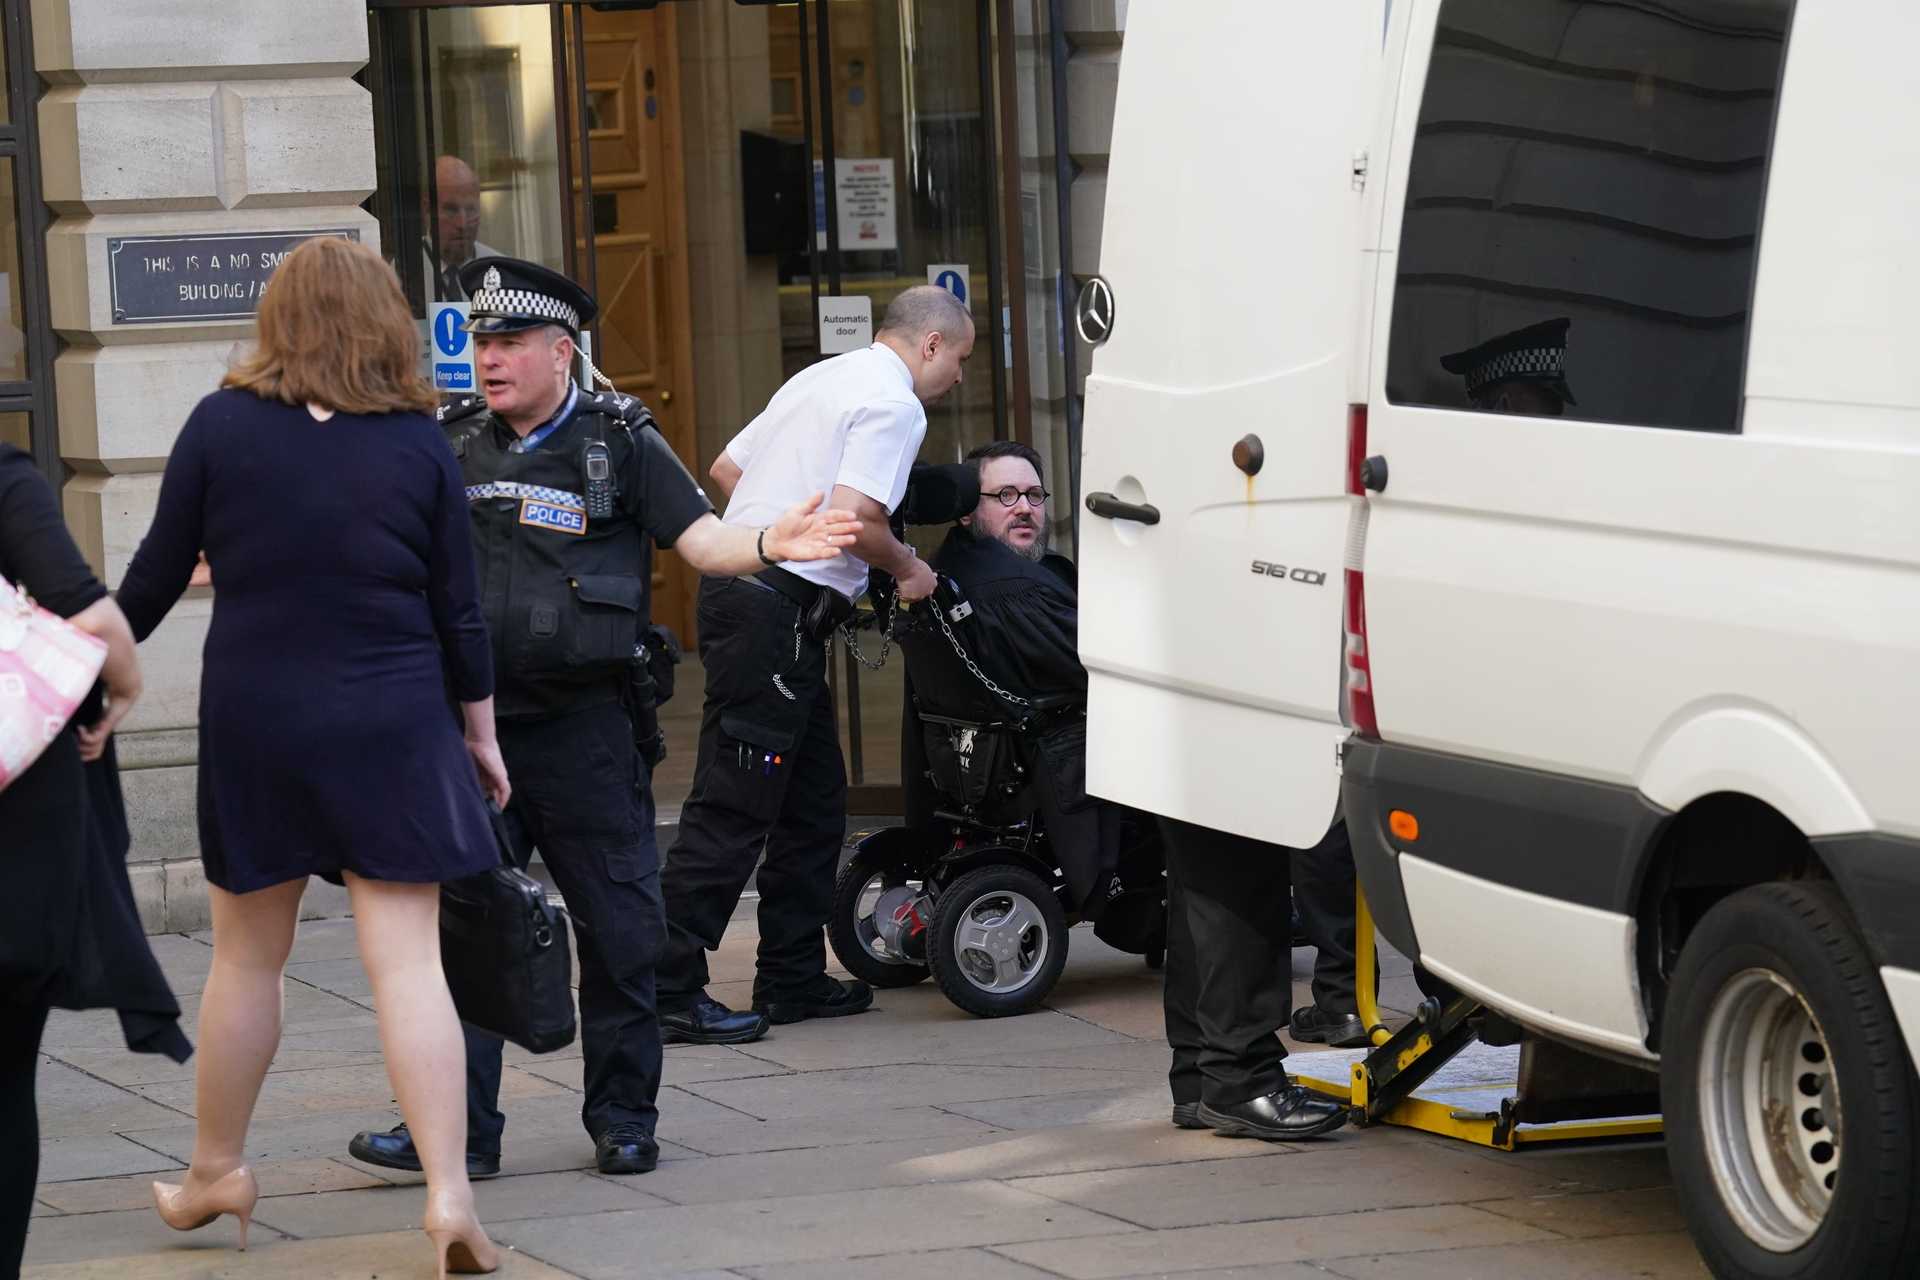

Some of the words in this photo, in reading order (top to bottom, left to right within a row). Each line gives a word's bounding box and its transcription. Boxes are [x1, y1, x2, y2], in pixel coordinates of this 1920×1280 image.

[144, 256, 174, 272] THIS
[186, 255, 200, 270] IS
[210, 255, 221, 269] A
[230, 254, 250, 269] NO
[823, 314, 869, 324] Automatic
[835, 327, 857, 336] door
[453, 370, 471, 381] clear
[527, 505, 581, 528] POLICE
[1251, 559, 1287, 579] 516
[1289, 567, 1327, 586] CDI
